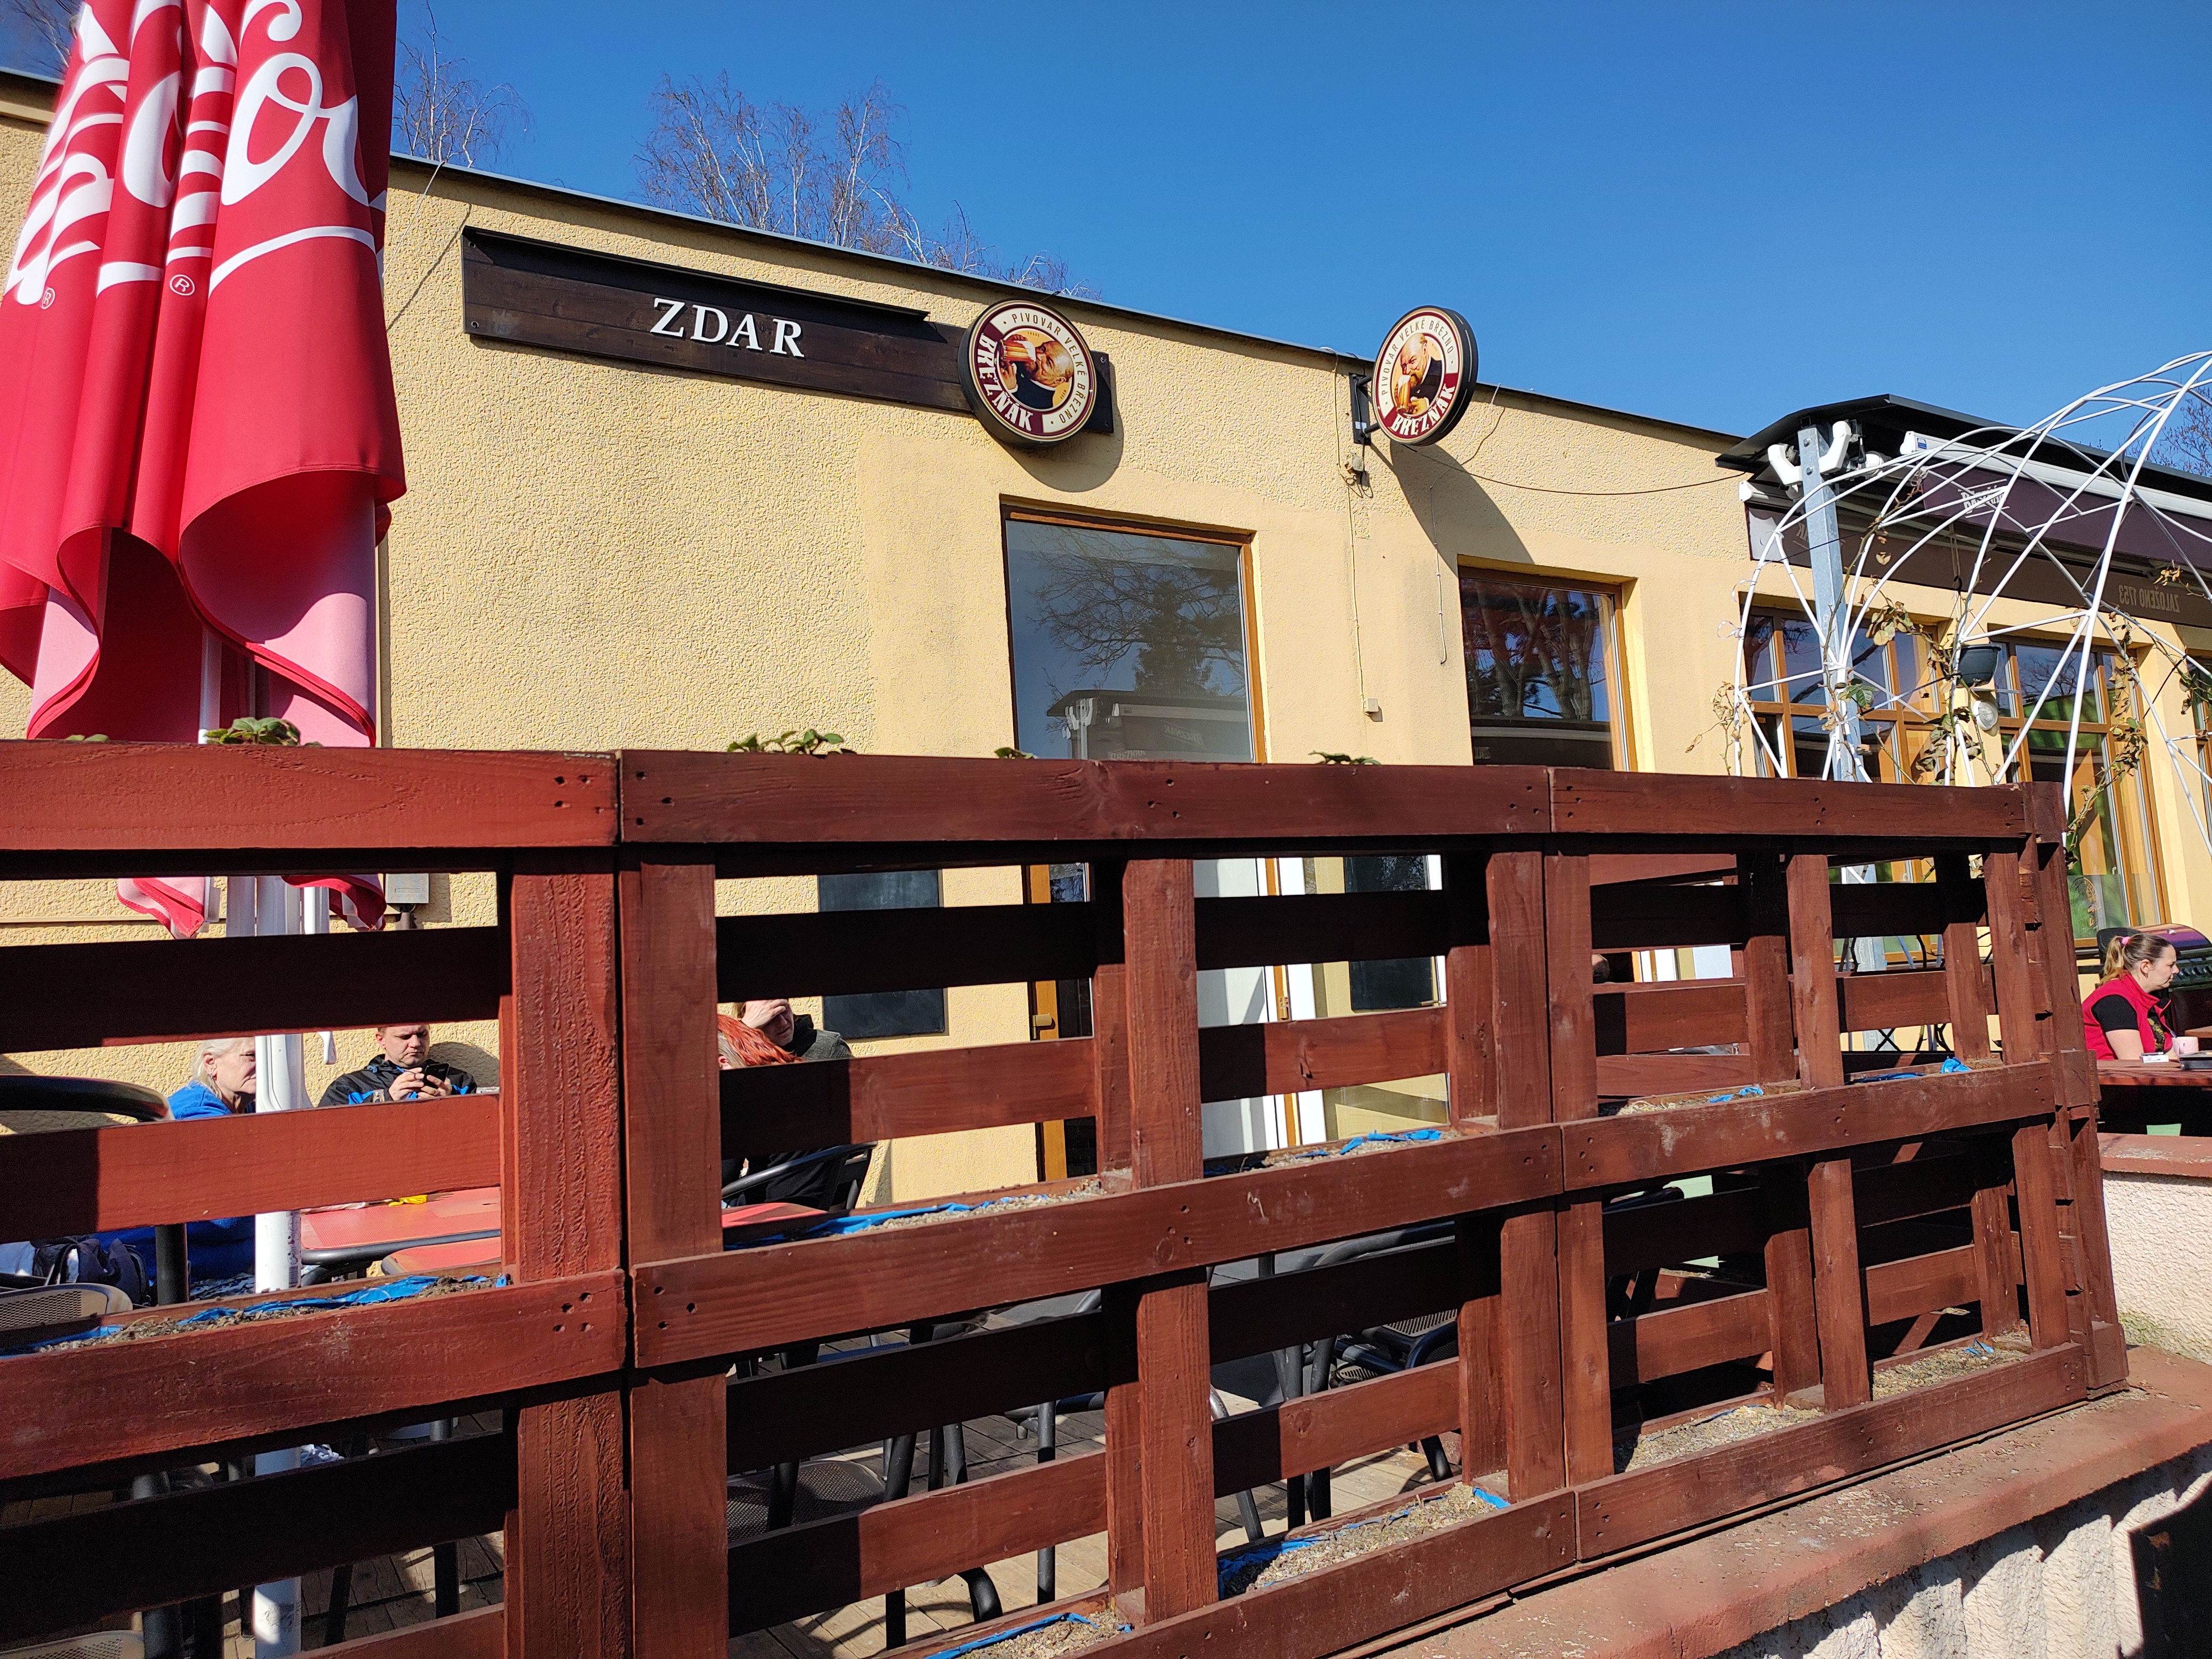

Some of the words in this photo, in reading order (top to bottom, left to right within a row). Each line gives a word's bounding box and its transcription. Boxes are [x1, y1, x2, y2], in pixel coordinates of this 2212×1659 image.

[650, 298, 804, 357] ZDAR
[1011, 312, 1061, 336] PIVOVAR
[1065, 337, 1087, 377] VELKÉ
[1381, 343, 1399, 395] PIVOVAR
[1399, 318, 1425, 341] VELKÉ
[1428, 320, 1454, 354] BŘEZNO
[1058, 383, 1086, 424] BŘEZNO
